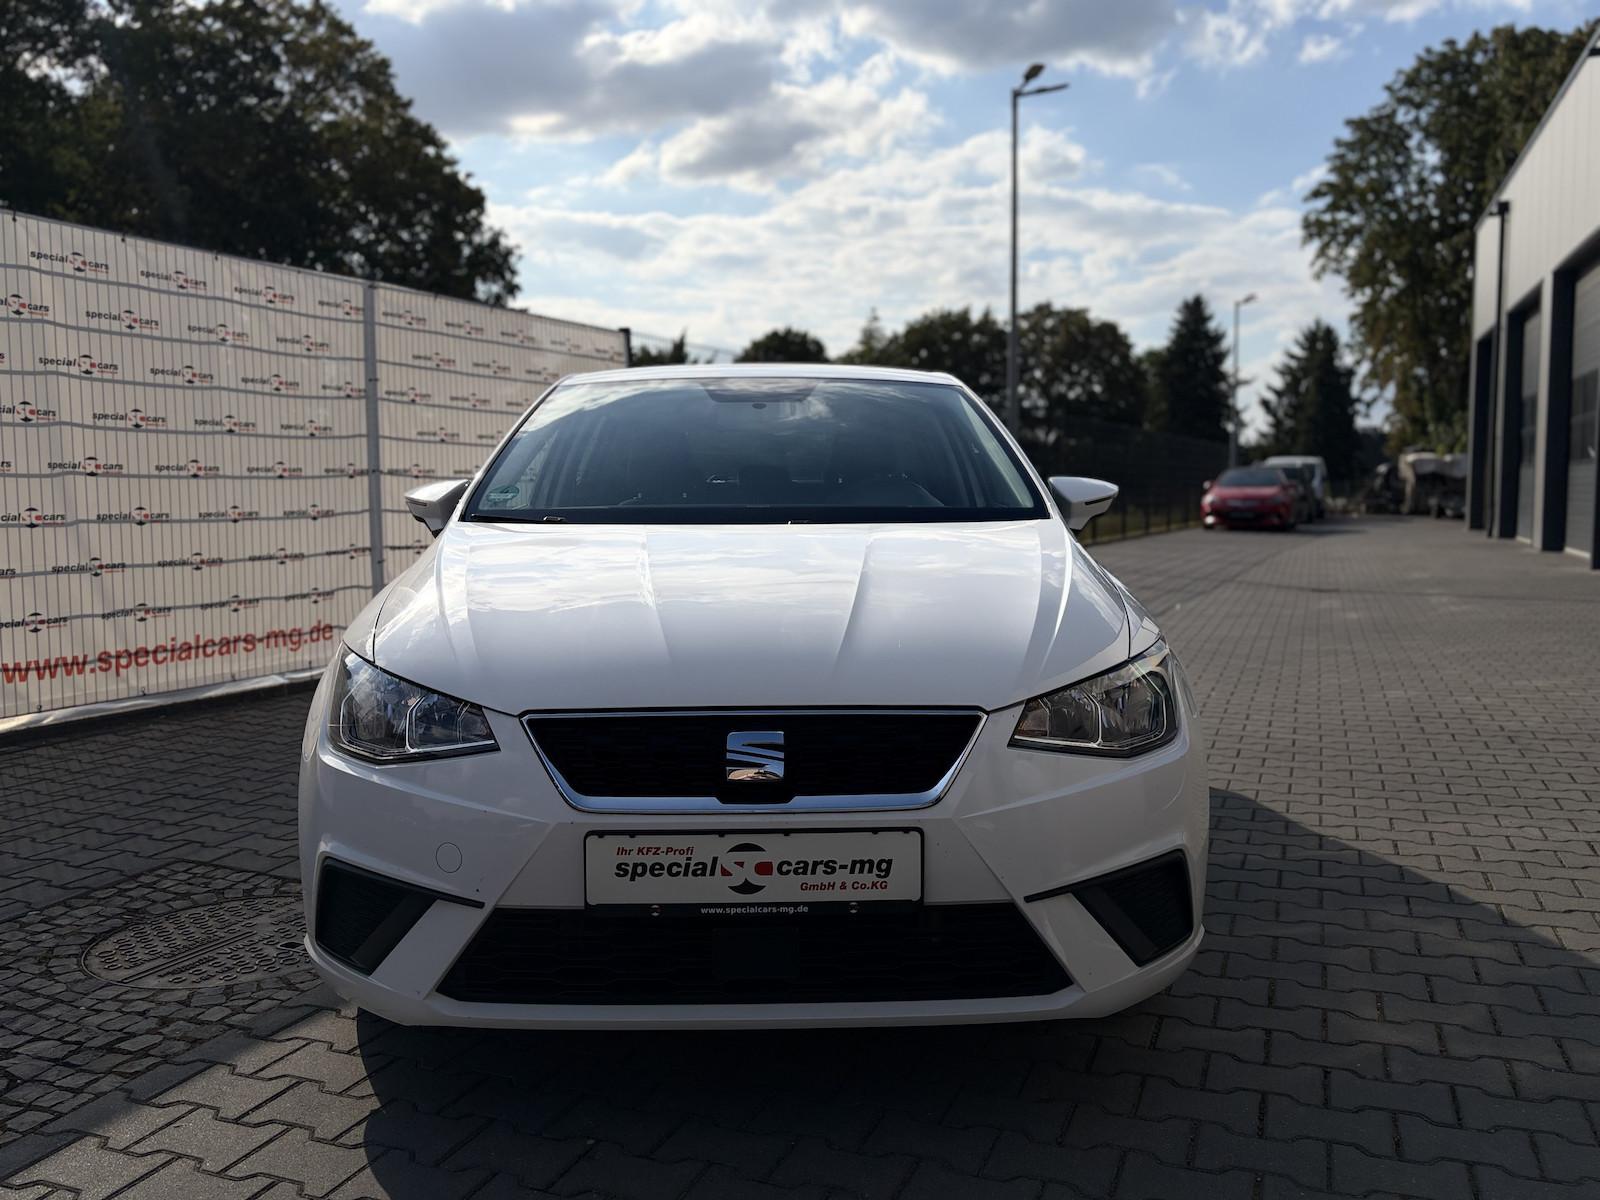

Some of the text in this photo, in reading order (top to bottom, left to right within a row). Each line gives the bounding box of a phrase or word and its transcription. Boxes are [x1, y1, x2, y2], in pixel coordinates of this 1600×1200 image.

[30, 250, 109, 270] special cars
[140, 270, 172, 281] special
[28, 304, 49, 312] cars
[85, 310, 159, 327] special cars
[38, 355, 118, 371] special cars
[150, 367, 181, 377] special
[92, 411, 166, 423] special cars
[47, 460, 80, 470] special
[155, 464, 186, 472] special
[96, 511, 131, 521] special
[51, 563, 89, 574] special
[101, 608, 134, 620] special
[47, 616, 68, 624] cars
[2, 619, 333, 684] www.specialcars-mg.de
[616, 846, 694, 856] Ihr KFZ-Profi
[614, 856, 894, 882] special cars-mg
[800, 880, 888, 891] GmbH & Co.KG
[700, 904, 809, 915] www.specialcars-mg.de
